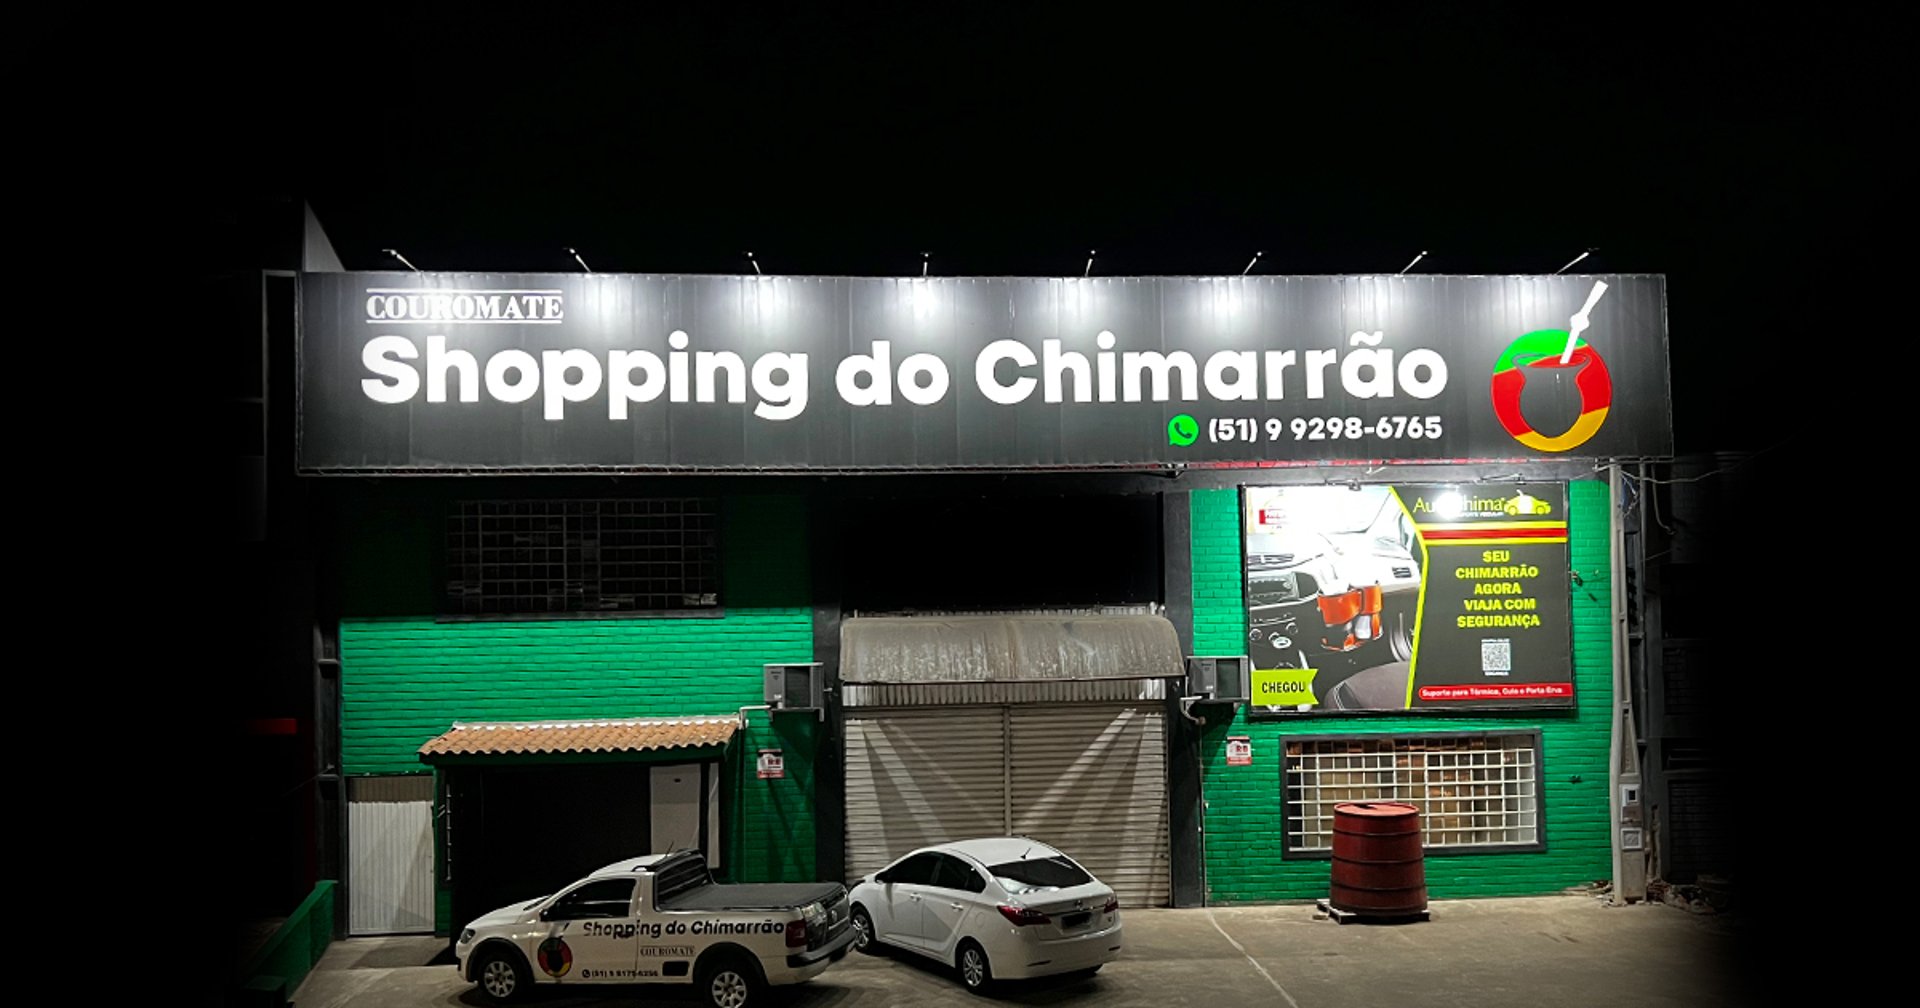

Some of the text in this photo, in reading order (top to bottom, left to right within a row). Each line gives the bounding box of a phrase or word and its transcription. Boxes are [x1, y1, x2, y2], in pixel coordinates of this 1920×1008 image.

[366, 295, 564, 320] COUROMATE
[361, 330, 1448, 420] Shopping do Chimarrão
[1208, 415, 1443, 443] (51) 9 9298-6765
[1482, 550, 1510, 563] SEU
[1455, 563, 1539, 579] CHIMARRÃO
[1474, 582, 1522, 595] AGORA
[1463, 598, 1536, 611] VIAJA COM
[1457, 614, 1540, 629] SEGURANÇA
[1422, 689, 1451, 697] Suporte
[583, 919, 784, 939] Shopping do Chimarrão
